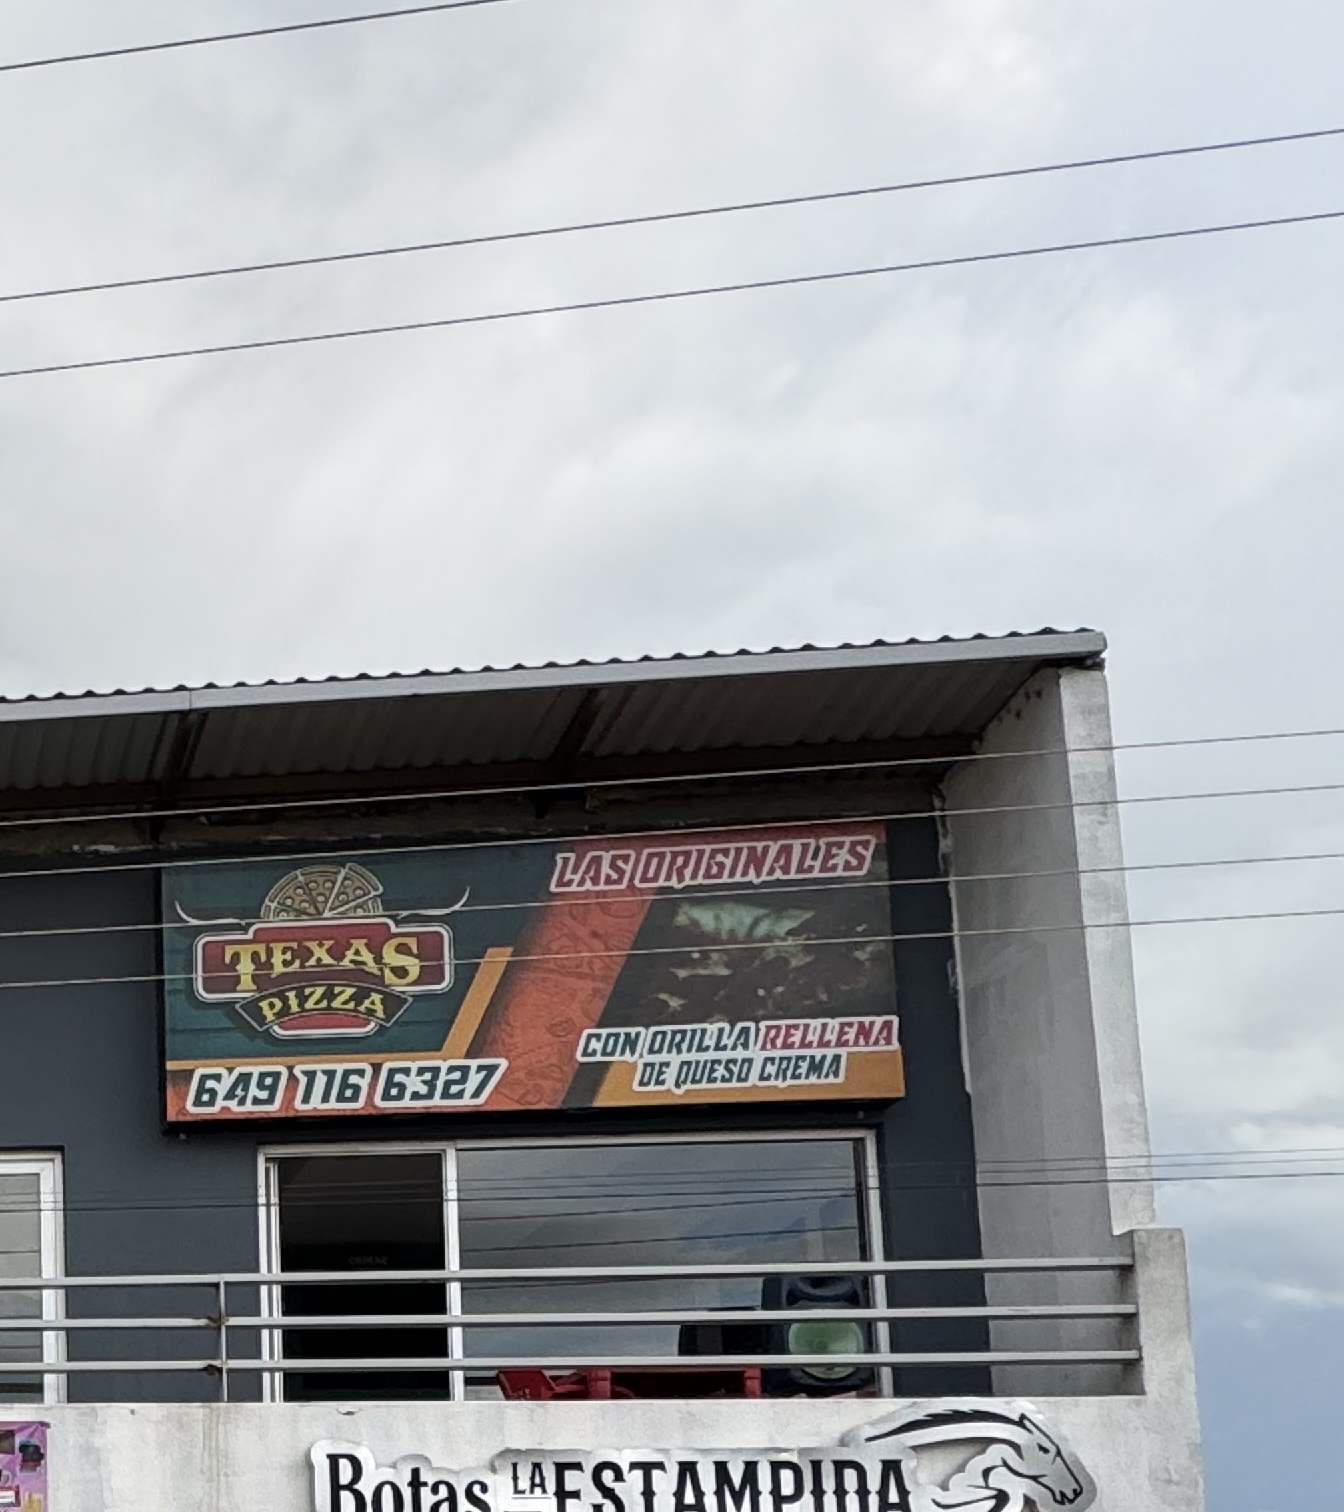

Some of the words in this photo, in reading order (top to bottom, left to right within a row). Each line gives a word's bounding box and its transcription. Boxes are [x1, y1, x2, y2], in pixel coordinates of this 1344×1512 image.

[555, 852, 631, 888] LAS
[638, 839, 871, 884] ORIGINALES
[224, 936, 420, 992] TEXAS
[257, 985, 387, 1022] PIZZA
[580, 1030, 643, 1058] CON
[647, 1026, 752, 1055] ORILLA
[762, 1019, 895, 1050] RELLENA
[191, 1068, 282, 1108] 649
[297, 1067, 367, 1105] 116
[380, 1063, 502, 1102] 6327
[638, 1061, 667, 1088] DE
[676, 1057, 754, 1088] QUESO
[758, 1053, 843, 1082] CREMA
[511, 1461, 548, 1496] LA
